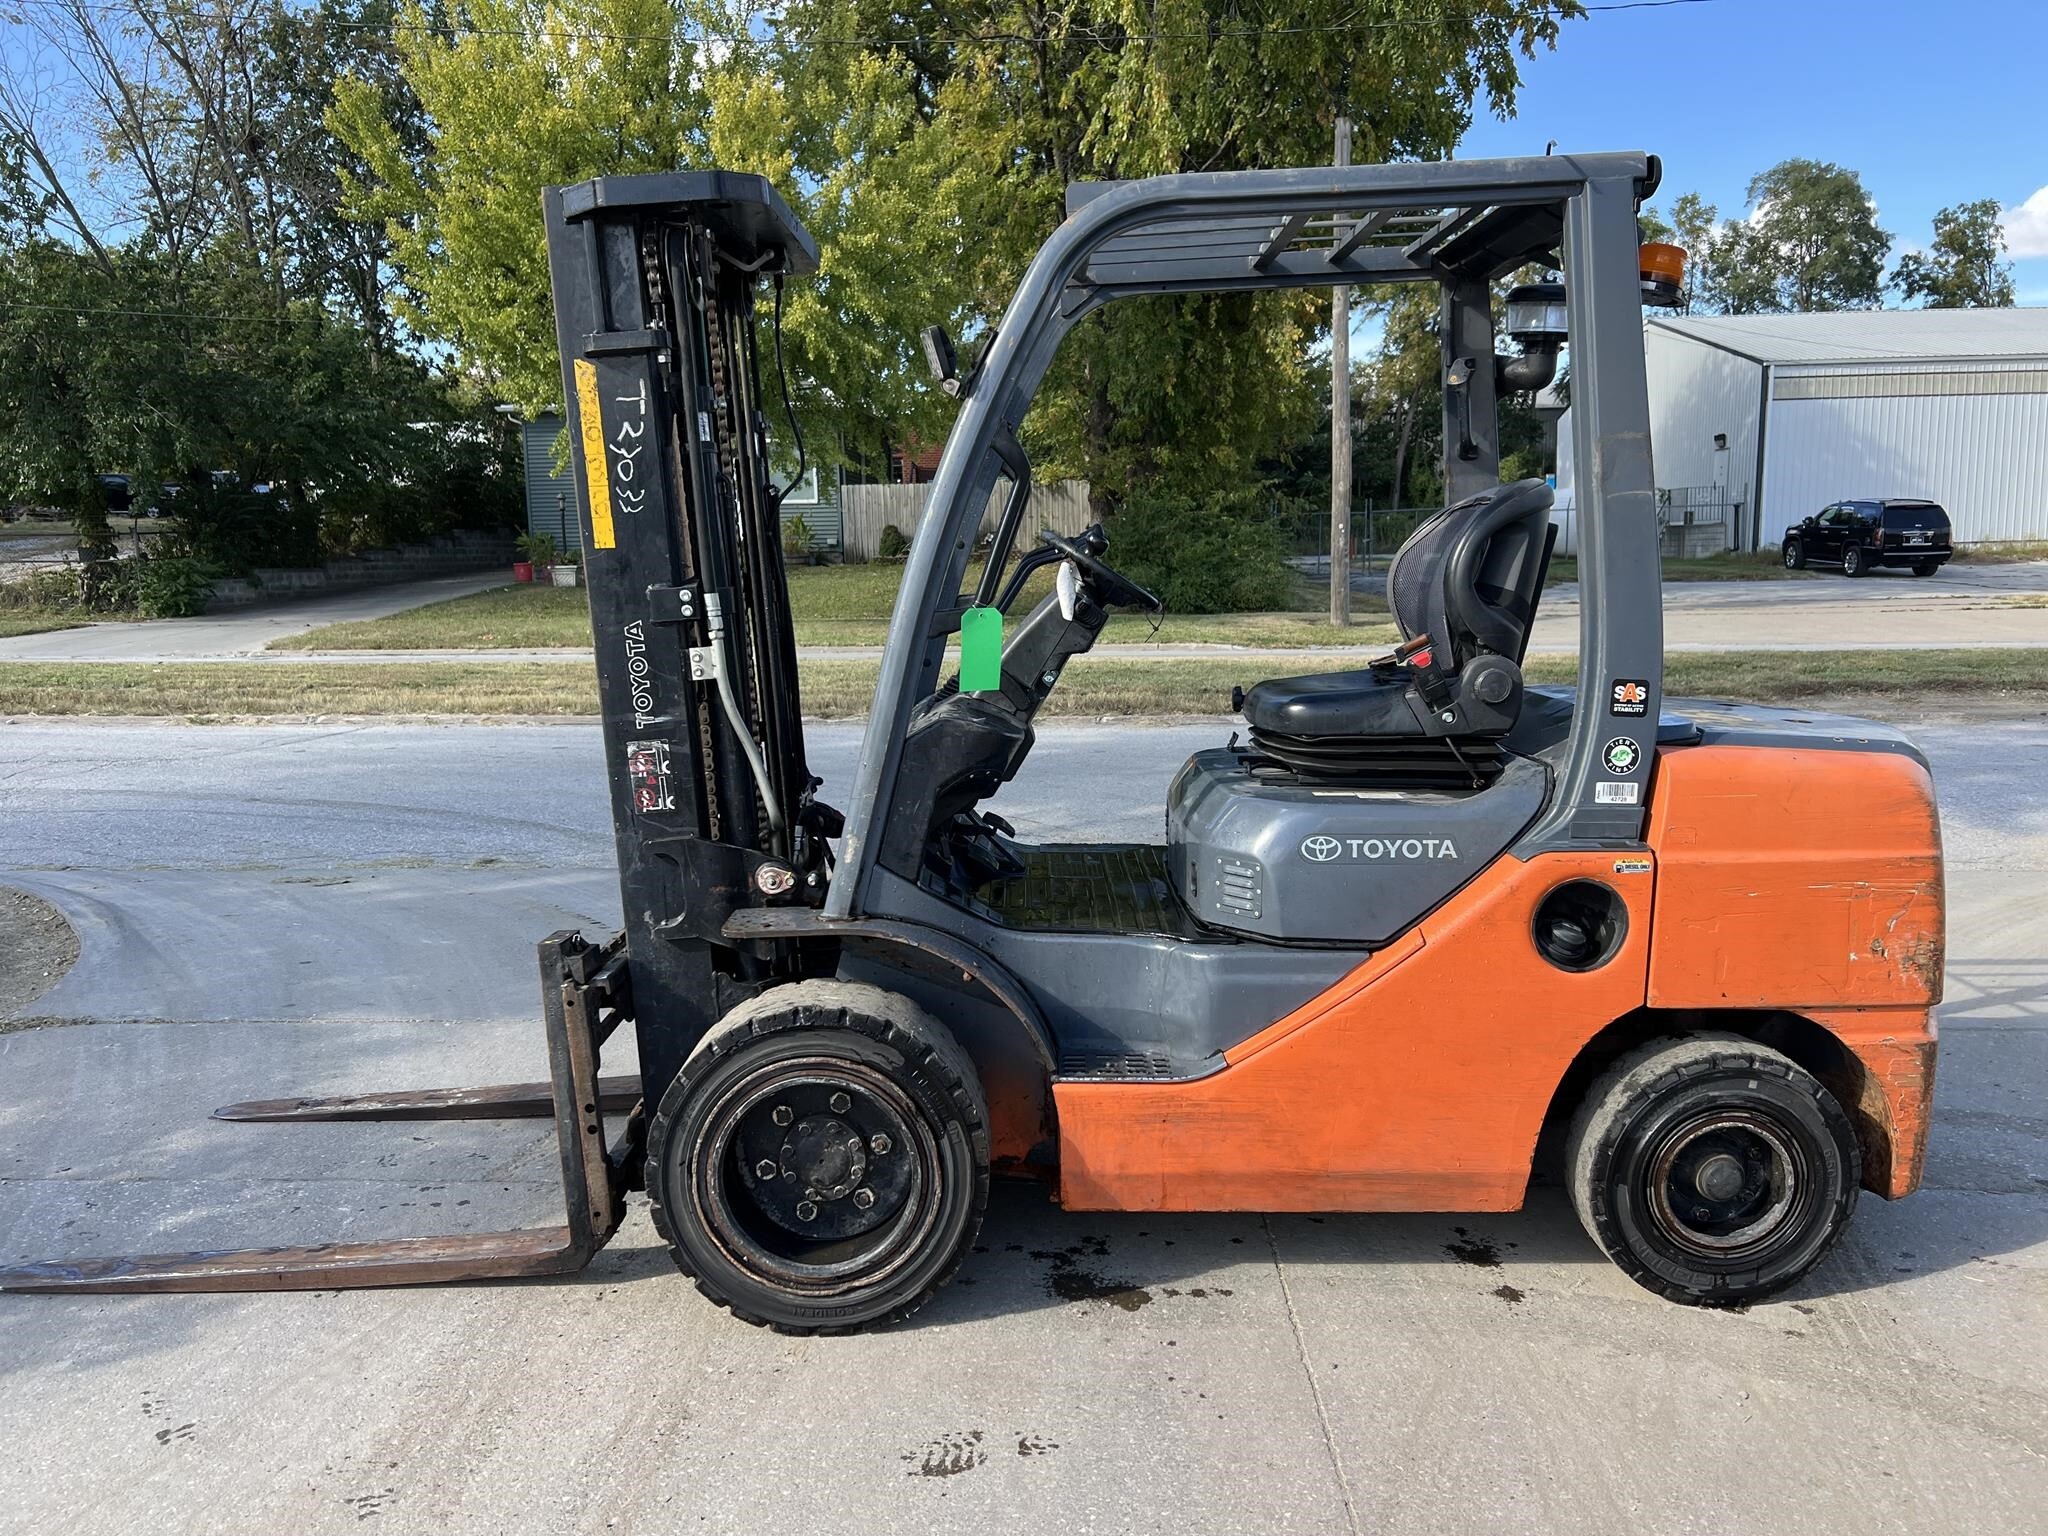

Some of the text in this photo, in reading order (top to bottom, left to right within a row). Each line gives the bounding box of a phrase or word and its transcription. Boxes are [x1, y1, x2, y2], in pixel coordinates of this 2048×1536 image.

[624, 619, 654, 730] TOYOTA
[1614, 682, 1646, 703] SAS
[1609, 739, 1630, 748] TIER
[1607, 762, 1634, 773] FINAL
[1346, 839, 1458, 859] TOYOTA
